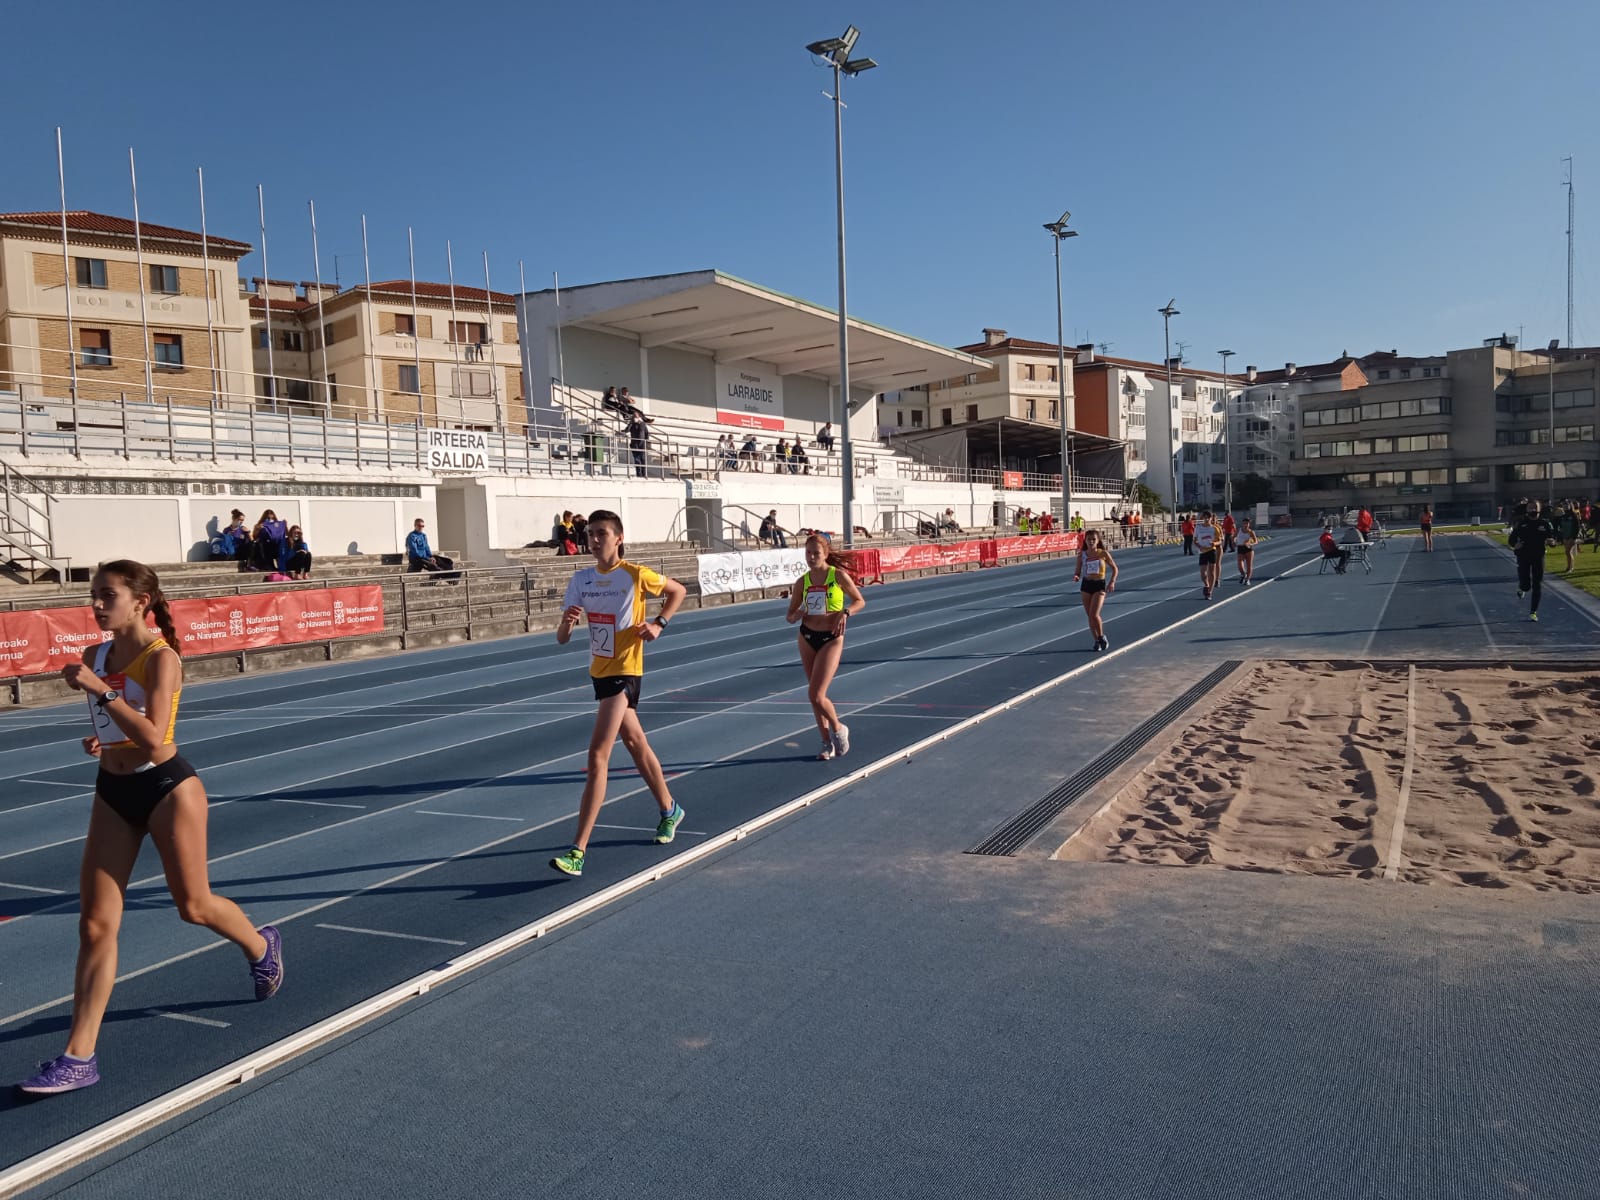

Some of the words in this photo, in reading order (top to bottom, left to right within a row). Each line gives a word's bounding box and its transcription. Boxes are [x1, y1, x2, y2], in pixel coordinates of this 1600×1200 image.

[728, 383, 773, 403] LARRABIDE
[430, 431, 485, 449] IRTEERA
[431, 451, 485, 469] SALIDA
[301, 610, 331, 619] Gobierno
[190, 620, 226, 630] Gobierno
[246, 615, 283, 625] Nafarroako
[306, 620, 332, 628] Navarra
[247, 625, 279, 635] Gobernua
[55, 632, 98, 643] Gobierno
[184, 634, 195, 642] de
[197, 631, 227, 640] Navarra
[48, 646, 60, 656] de
